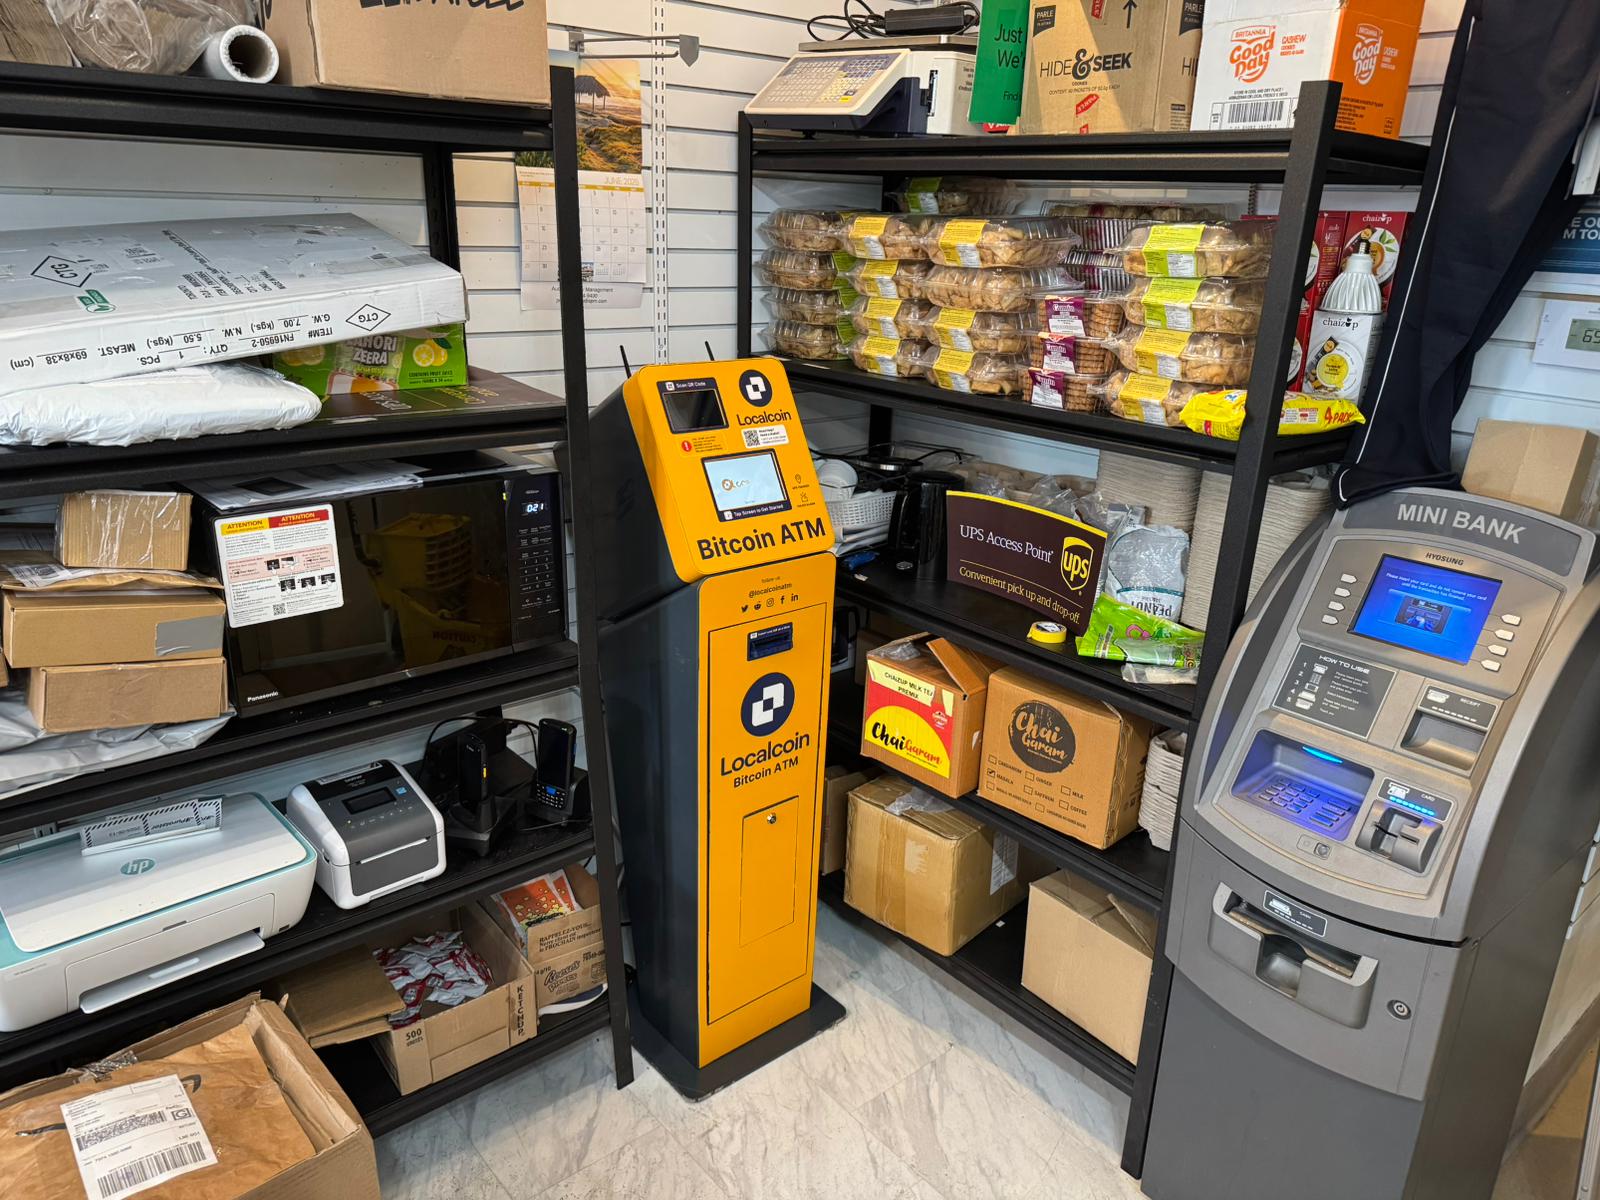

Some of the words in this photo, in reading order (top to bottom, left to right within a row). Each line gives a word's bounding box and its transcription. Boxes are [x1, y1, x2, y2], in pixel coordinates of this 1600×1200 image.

[1184, 2, 1202, 13] PARLE
[994, 24, 1022, 43] Just
[1235, 29, 1266, 38] BRITANNIA
[1282, 34, 1306, 44] CASHEW
[1229, 32, 1276, 64] Good
[1352, 36, 1382, 60] Good
[1234, 52, 1270, 79] Day
[1354, 56, 1378, 78] Day
[1004, 91, 1018, 101] Find
[51, 263, 78, 279] CTG
[284, 318, 301, 328] 7.00
[311, 314, 331, 324] G.W.
[358, 313, 379, 323] CTG
[1322, 317, 1359, 331] chaizup
[222, 327, 242, 338] N.W.
[251, 320, 274, 332] (kgs.)
[308, 327, 333, 339] ITEM#
[146, 336, 173, 349] (kgs.)
[183, 333, 202, 344] 5.50
[252, 333, 294, 347] FN16950-2
[344, 336, 397, 351] AHORI
[98, 342, 136, 356] MEAST.
[178, 351, 184, 359] 1
[10, 356, 34, 370] (cm)
[46, 352, 88, 365] 69x8x38
[136, 355, 160, 365] PCS.
[352, 350, 389, 365] ZEERA
[736, 409, 792, 426] Localcoin
[1324, 407, 1332, 424] 4
[1333, 412, 1352, 424] PACK
[281, 512, 315, 522] ATTENTION
[1397, 503, 1448, 525] MINI
[1452, 510, 1526, 544] BANK
[227, 520, 263, 530] ATTENTION
[697, 529, 775, 560] Bitcoin
[781, 517, 826, 545] ATM
[960, 524, 984, 541] UPS
[986, 531, 1023, 552] Access
[1063, 550, 1089, 582] ups
[1425, 552, 1464, 566] HYOSUNG
[749, 583, 792, 598] @localcoinatm
[959, 566, 1006, 590] Convenient
[1007, 583, 1025, 596] pick
[1025, 590, 1036, 602] up
[1036, 594, 1051, 608] and
[1319, 655, 1338, 664] HOW
[1339, 660, 1351, 668] TO
[1351, 664, 1370, 674] USE
[884, 672, 908, 686] CHAIZUP
[908, 681, 923, 692] MILK
[247, 691, 279, 703] Panasonic
[897, 686, 920, 699] PREMIX
[1460, 697, 1481, 708] RECEIPT
[1016, 711, 1063, 744] Chai
[1022, 732, 1068, 760] Garam
[720, 731, 810, 777] Localcoin
[734, 766, 772, 789] Bitcoin
[774, 756, 799, 774] ATM
[1072, 791, 1084, 799] MILK
[1421, 794, 1436, 802] CARD
[1070, 804, 1088, 816] COFFEE
[127, 859, 150, 875] hp
[405, 1028, 423, 1040] 500
